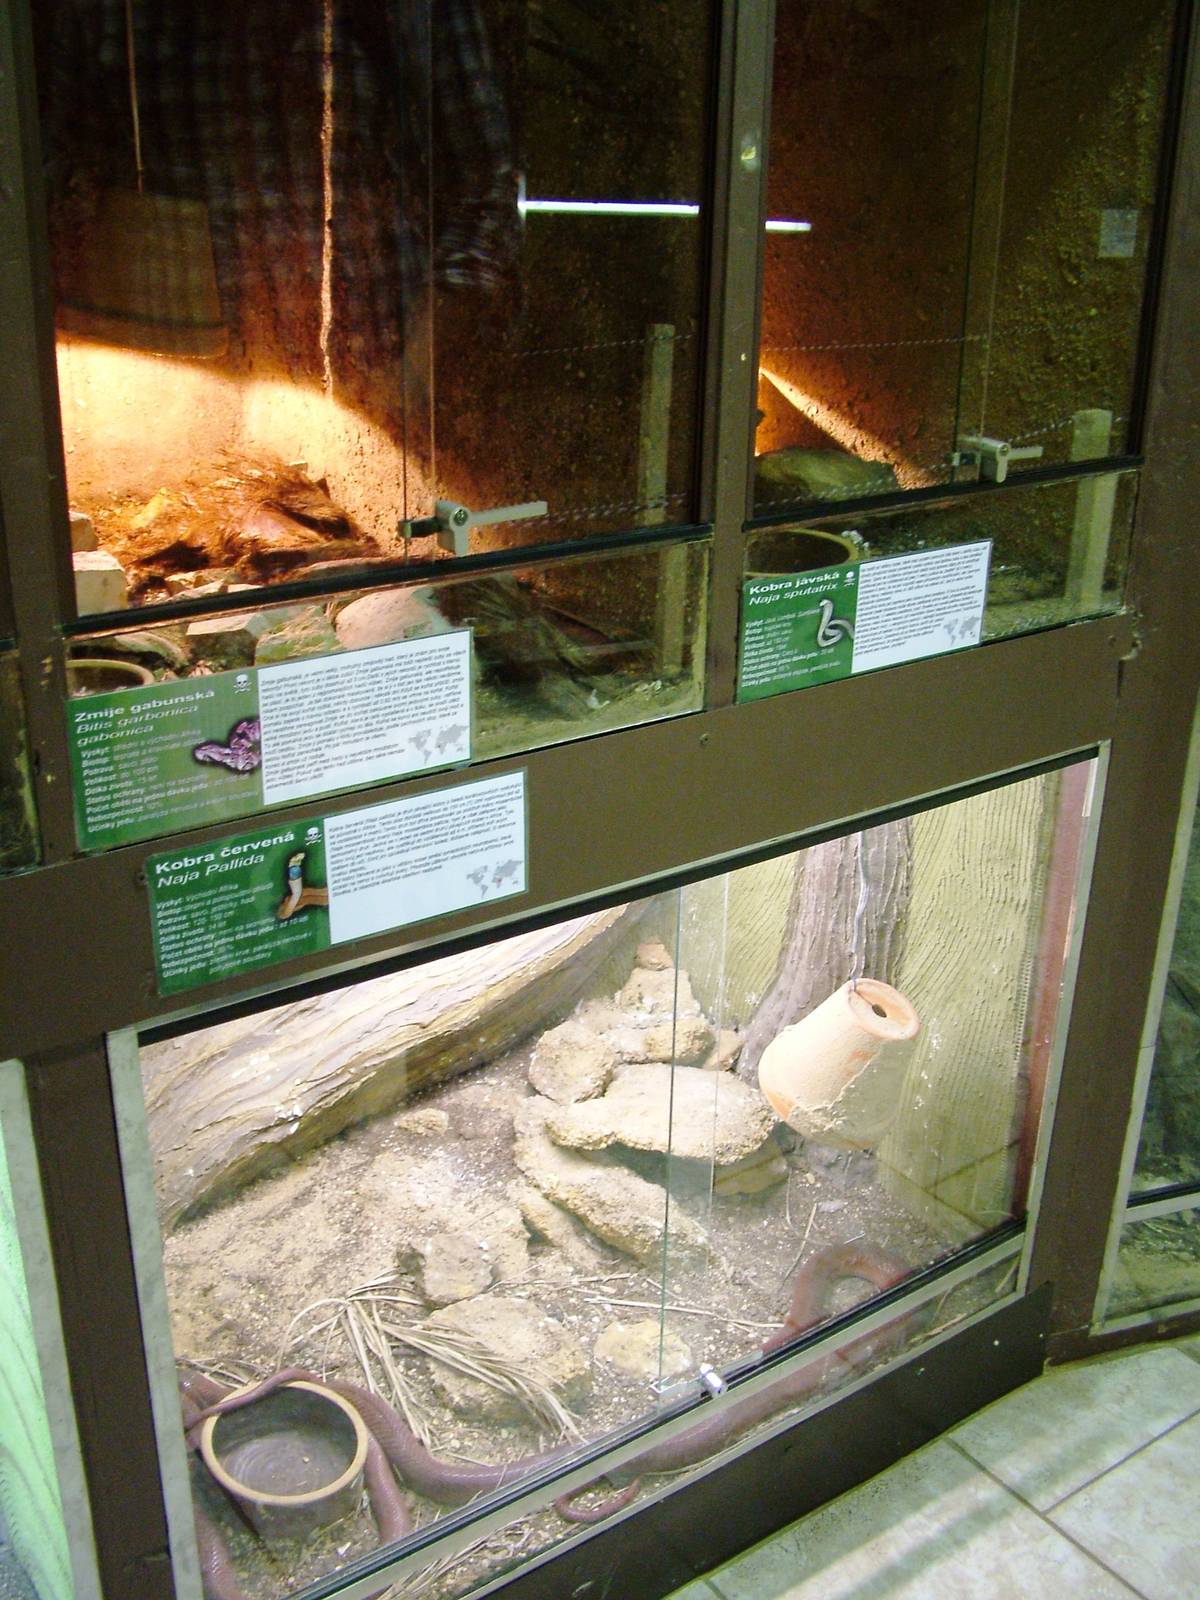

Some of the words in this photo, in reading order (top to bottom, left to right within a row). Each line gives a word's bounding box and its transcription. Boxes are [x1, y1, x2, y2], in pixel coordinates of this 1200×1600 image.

[749, 580, 793, 595] Kobra
[749, 593, 780, 606] Naja
[783, 583, 838, 599] sputatrix
[74, 706, 125, 722] Zmije
[130, 689, 215, 714] gabunská
[76, 720, 113, 734] Bitis
[117, 705, 199, 727] garbonica
[76, 724, 155, 747] gabonica
[155, 853, 215, 875] Kobra
[220, 831, 295, 858] červená
[156, 870, 200, 888] Naja
[205, 853, 265, 877] Pallida
